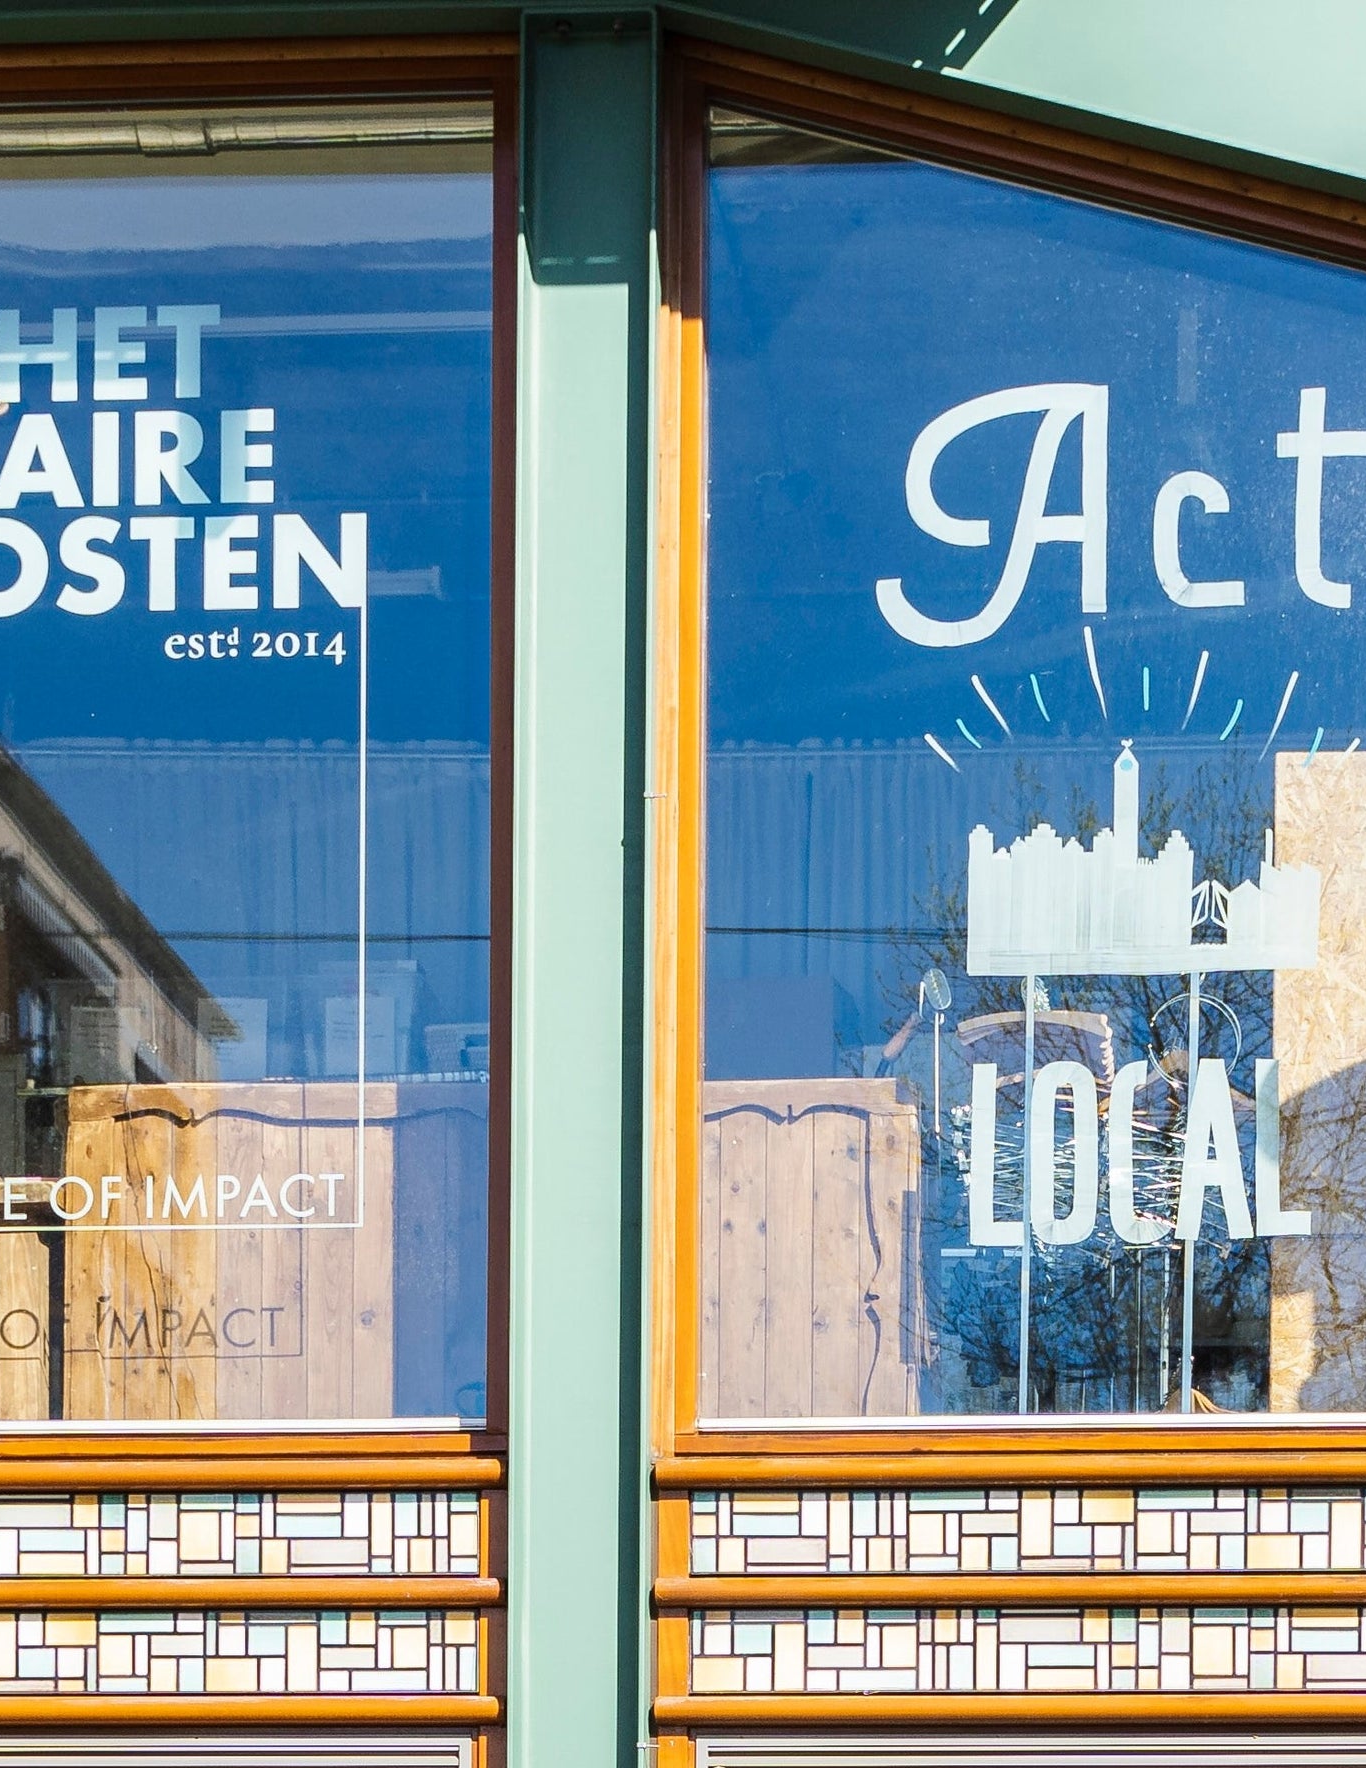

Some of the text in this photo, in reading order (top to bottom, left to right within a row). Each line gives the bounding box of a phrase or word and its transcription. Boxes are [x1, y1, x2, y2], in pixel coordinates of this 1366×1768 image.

[251, 630, 348, 667] 2014
[968, 1057, 1312, 1248] LOCAL
[50, 1175, 123, 1222] OF
[146, 1173, 346, 1219] IMPACT
